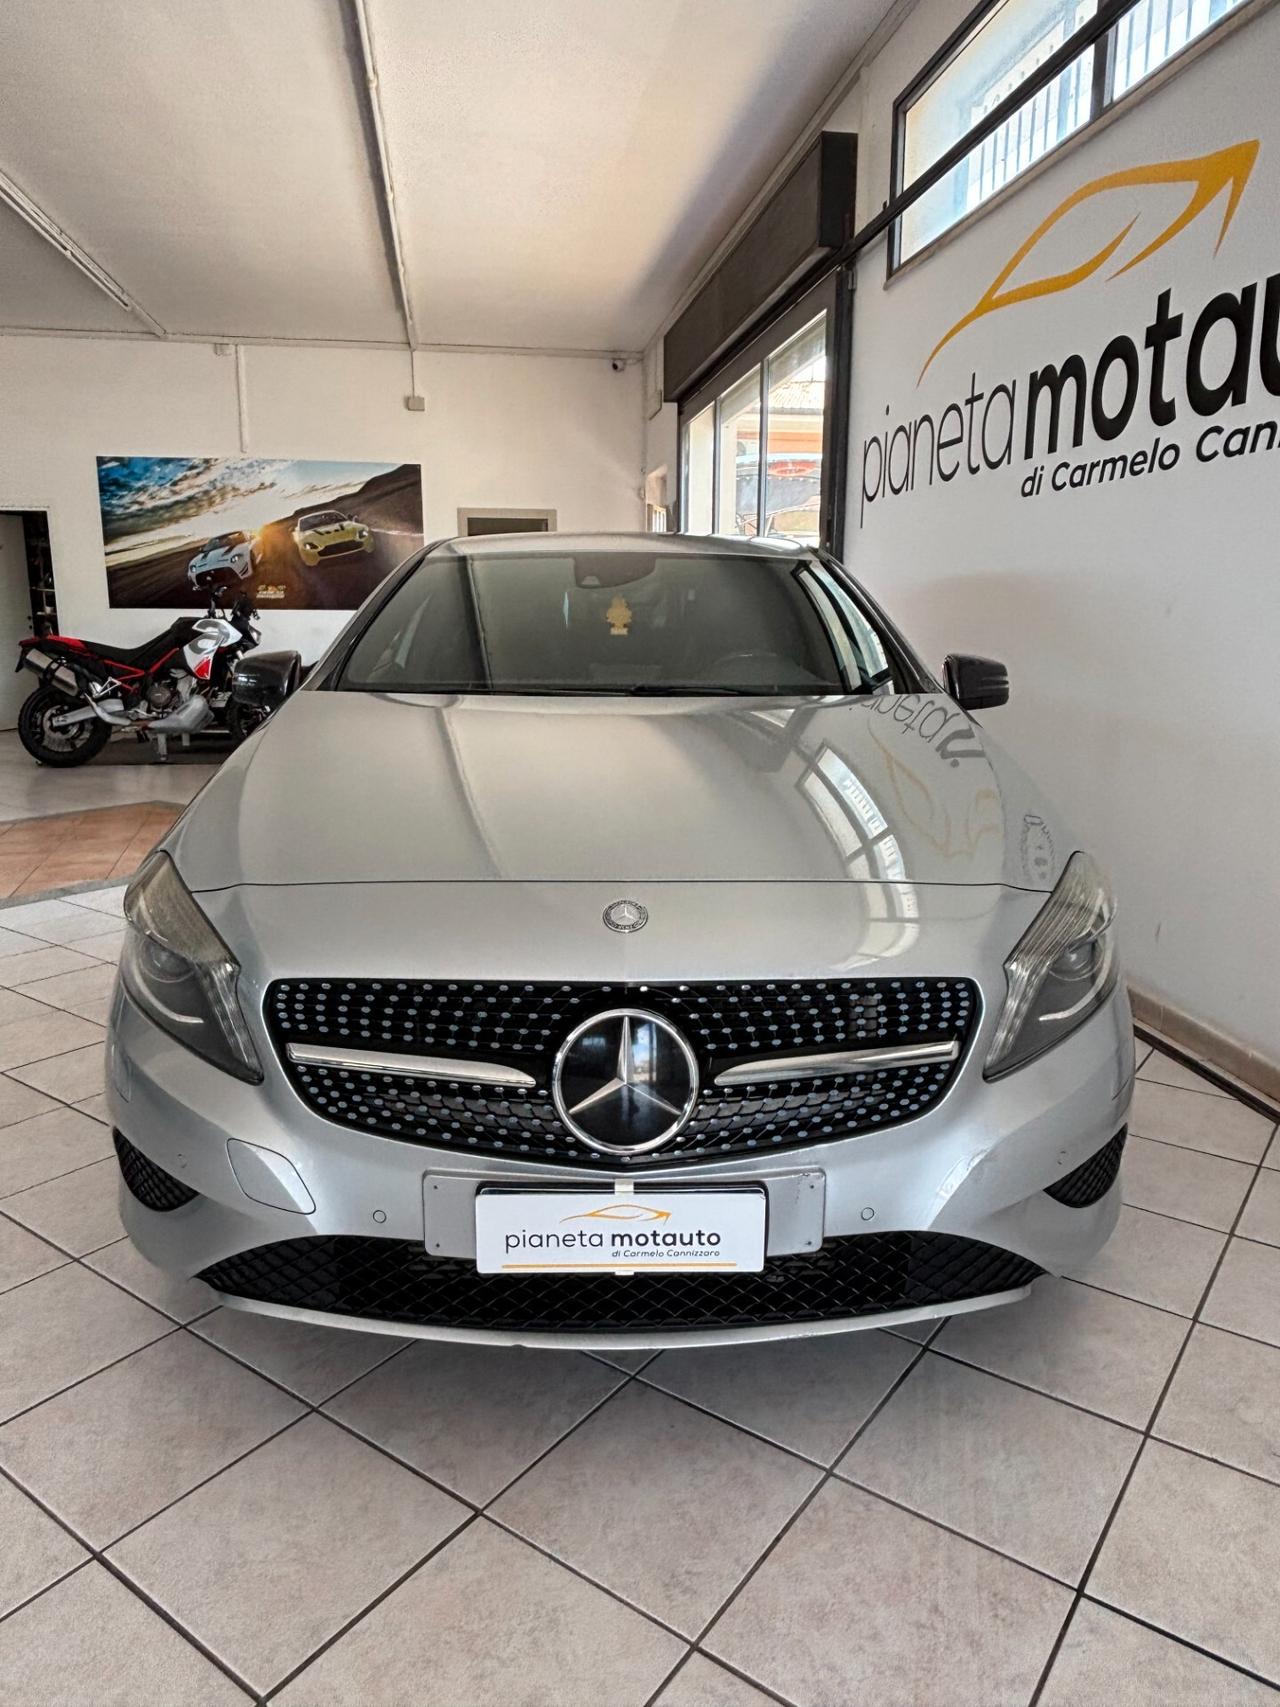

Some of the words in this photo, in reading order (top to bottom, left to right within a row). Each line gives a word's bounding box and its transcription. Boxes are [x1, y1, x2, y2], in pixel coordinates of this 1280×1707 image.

[860, 371, 1017, 529] pianeta
[1020, 464, 1046, 498] di
[1051, 436, 1181, 492] Carmelo
[1195, 420, 1280, 463] Can
[505, 1229, 604, 1254] pianeta
[611, 1229, 722, 1247] motauto
[612, 1248, 621, 1258] di
[623, 1249, 665, 1259] Carmelo
[666, 1248, 721, 1258] Cannizzaro
